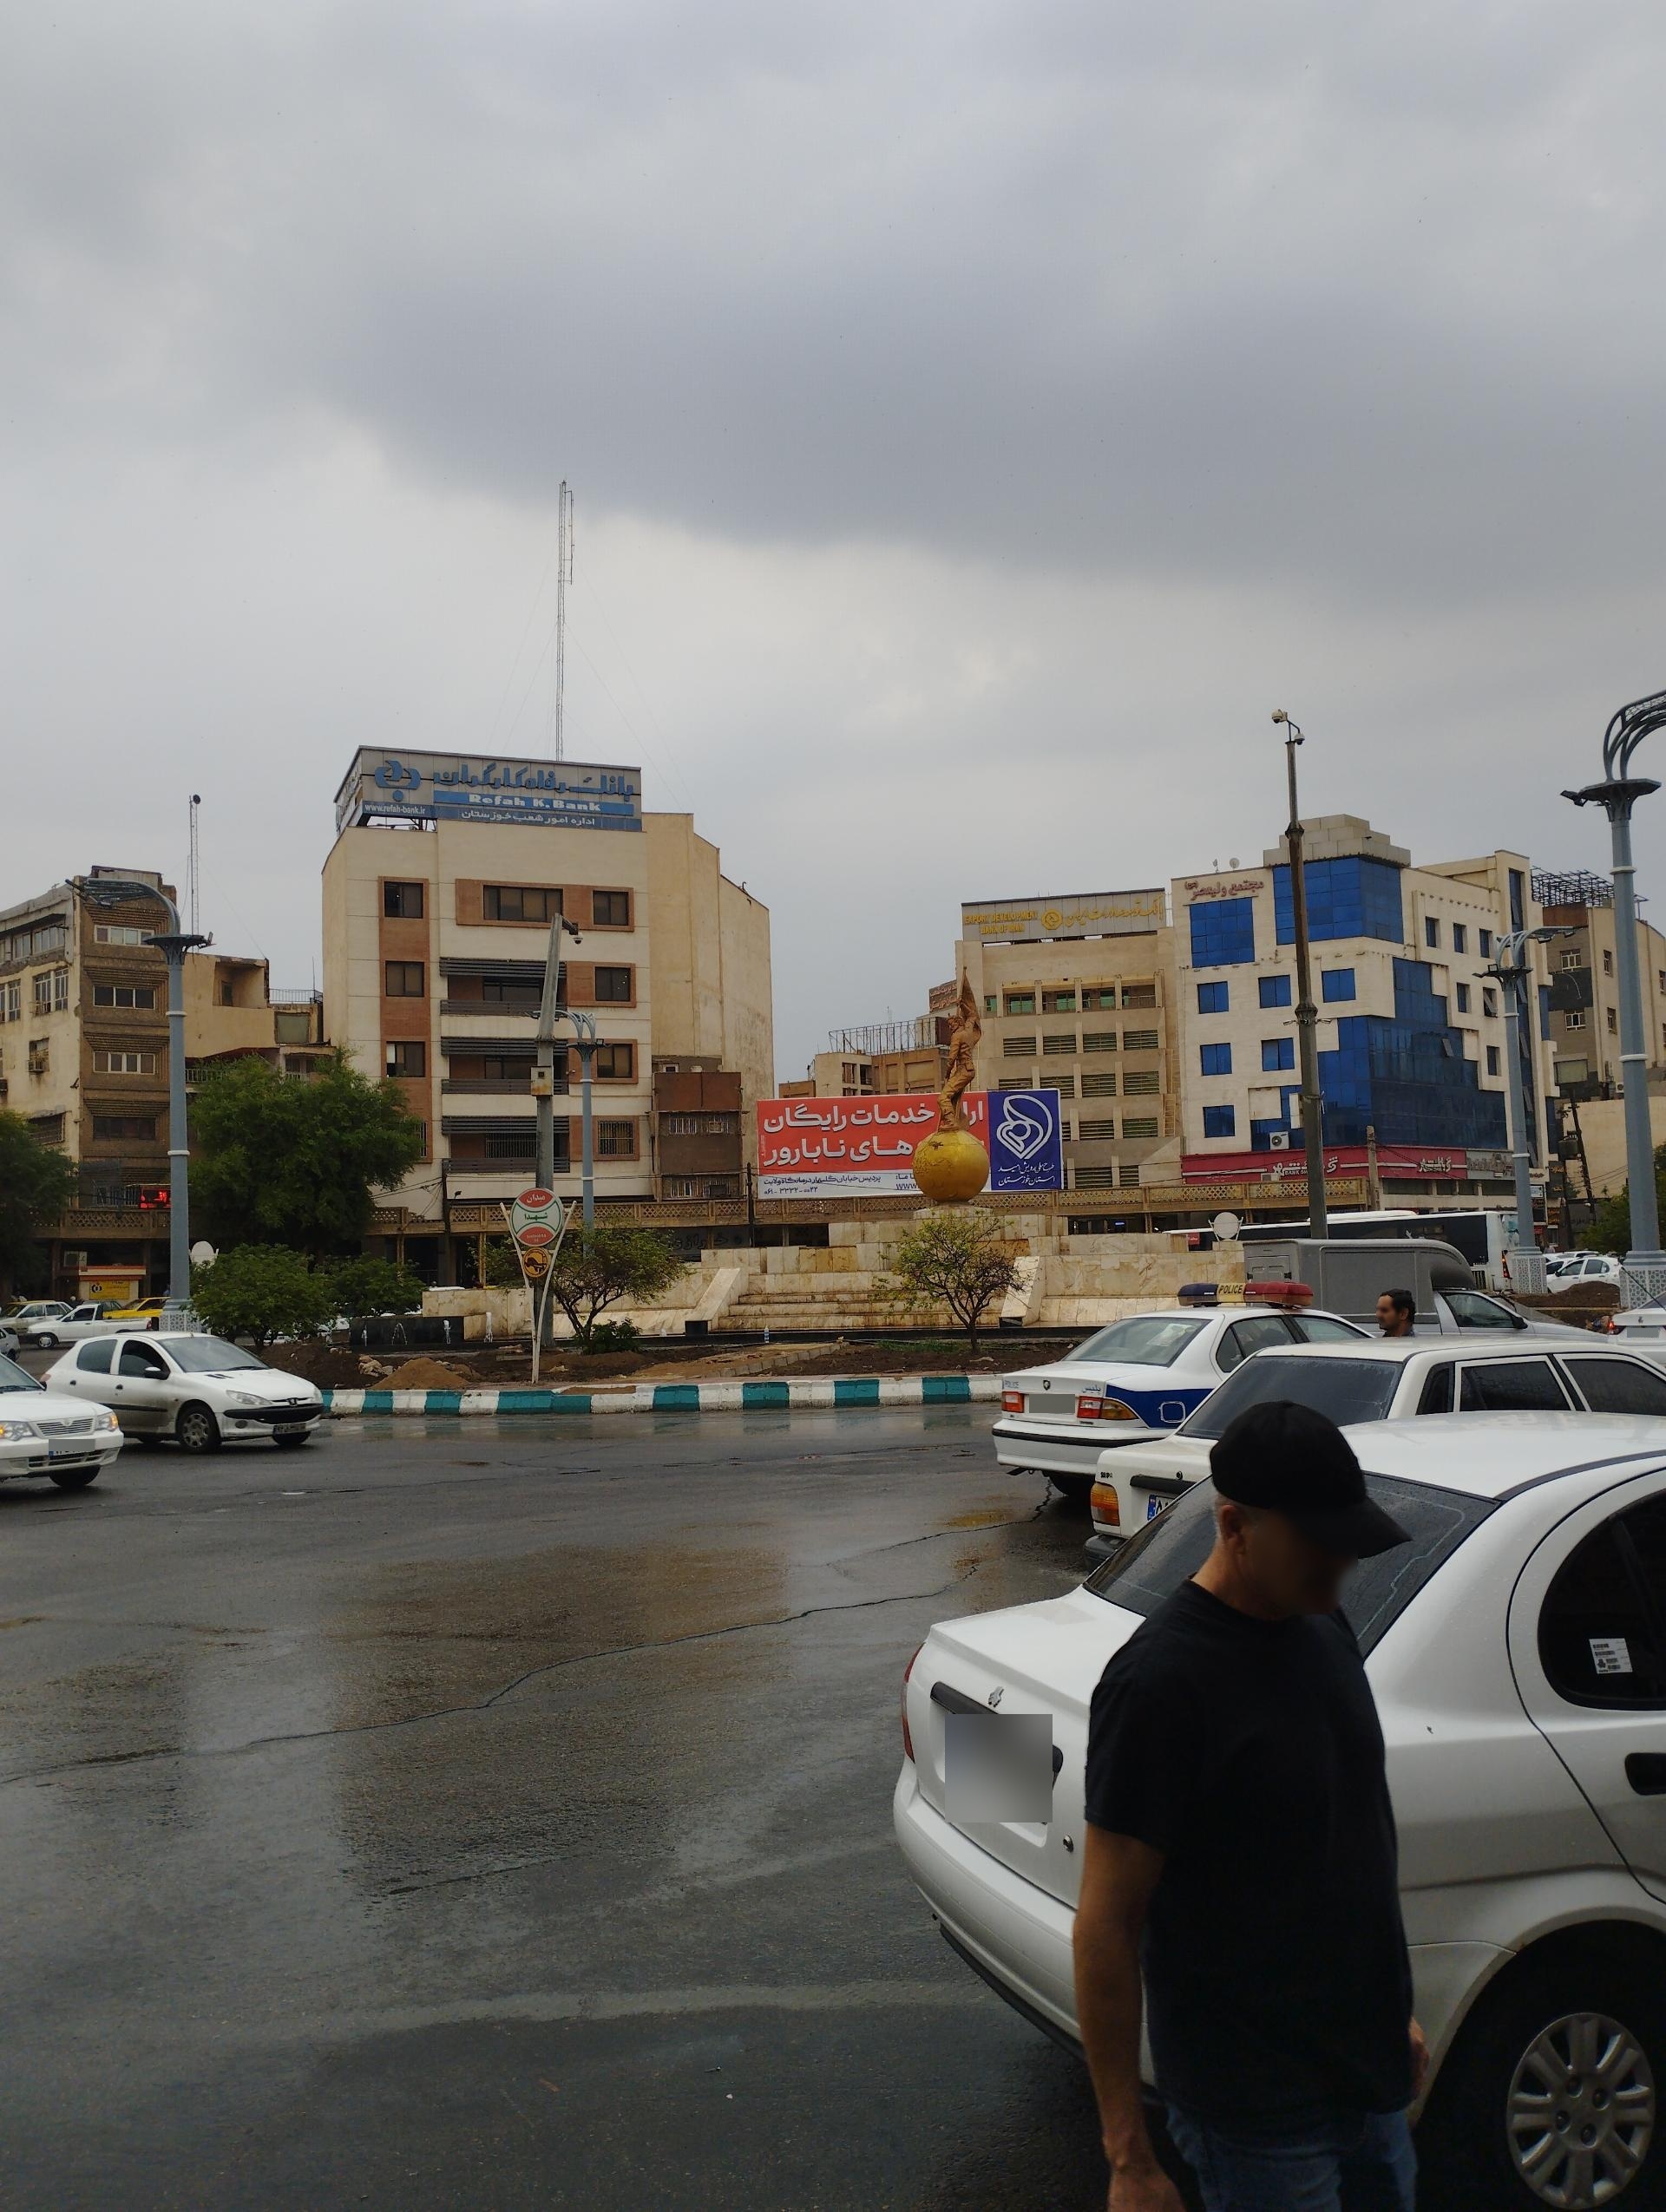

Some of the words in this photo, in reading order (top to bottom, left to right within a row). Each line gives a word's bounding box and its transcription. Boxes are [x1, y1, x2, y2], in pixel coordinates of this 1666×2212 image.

[433, 762, 528, 791] کارگران
[526, 769, 567, 794] رفاه
[569, 774, 633, 802] بانک
[469, 793, 526, 807] Refah
[364, 804, 426, 815] www.refah-bank.ir
[461, 809, 512, 821] خوزستان
[512, 812, 544, 822] شعب
[546, 815, 568, 824] امور
[571, 817, 595, 826] اداره
[1229, 880, 1264, 896] مجتمع
[764, 1103, 847, 1133] رایگان
[850, 1103, 935, 1125] خدمات
[764, 1137, 846, 1167] نابارور
[849, 1135, 914, 1162] های
[836, 1175, 859, 1183] خیابان
[858, 1175, 881, 1183] پردیس
[998, 1174, 1030, 1186] خوزستان
[1027, 1175, 1055, 1186] استان
[526, 1193, 546, 1203] میدان
[524, 1212, 548, 1221] شهدا
[1218, 1284, 1243, 1294] POLICE
[1082, 1384, 1102, 1395] پلیس
